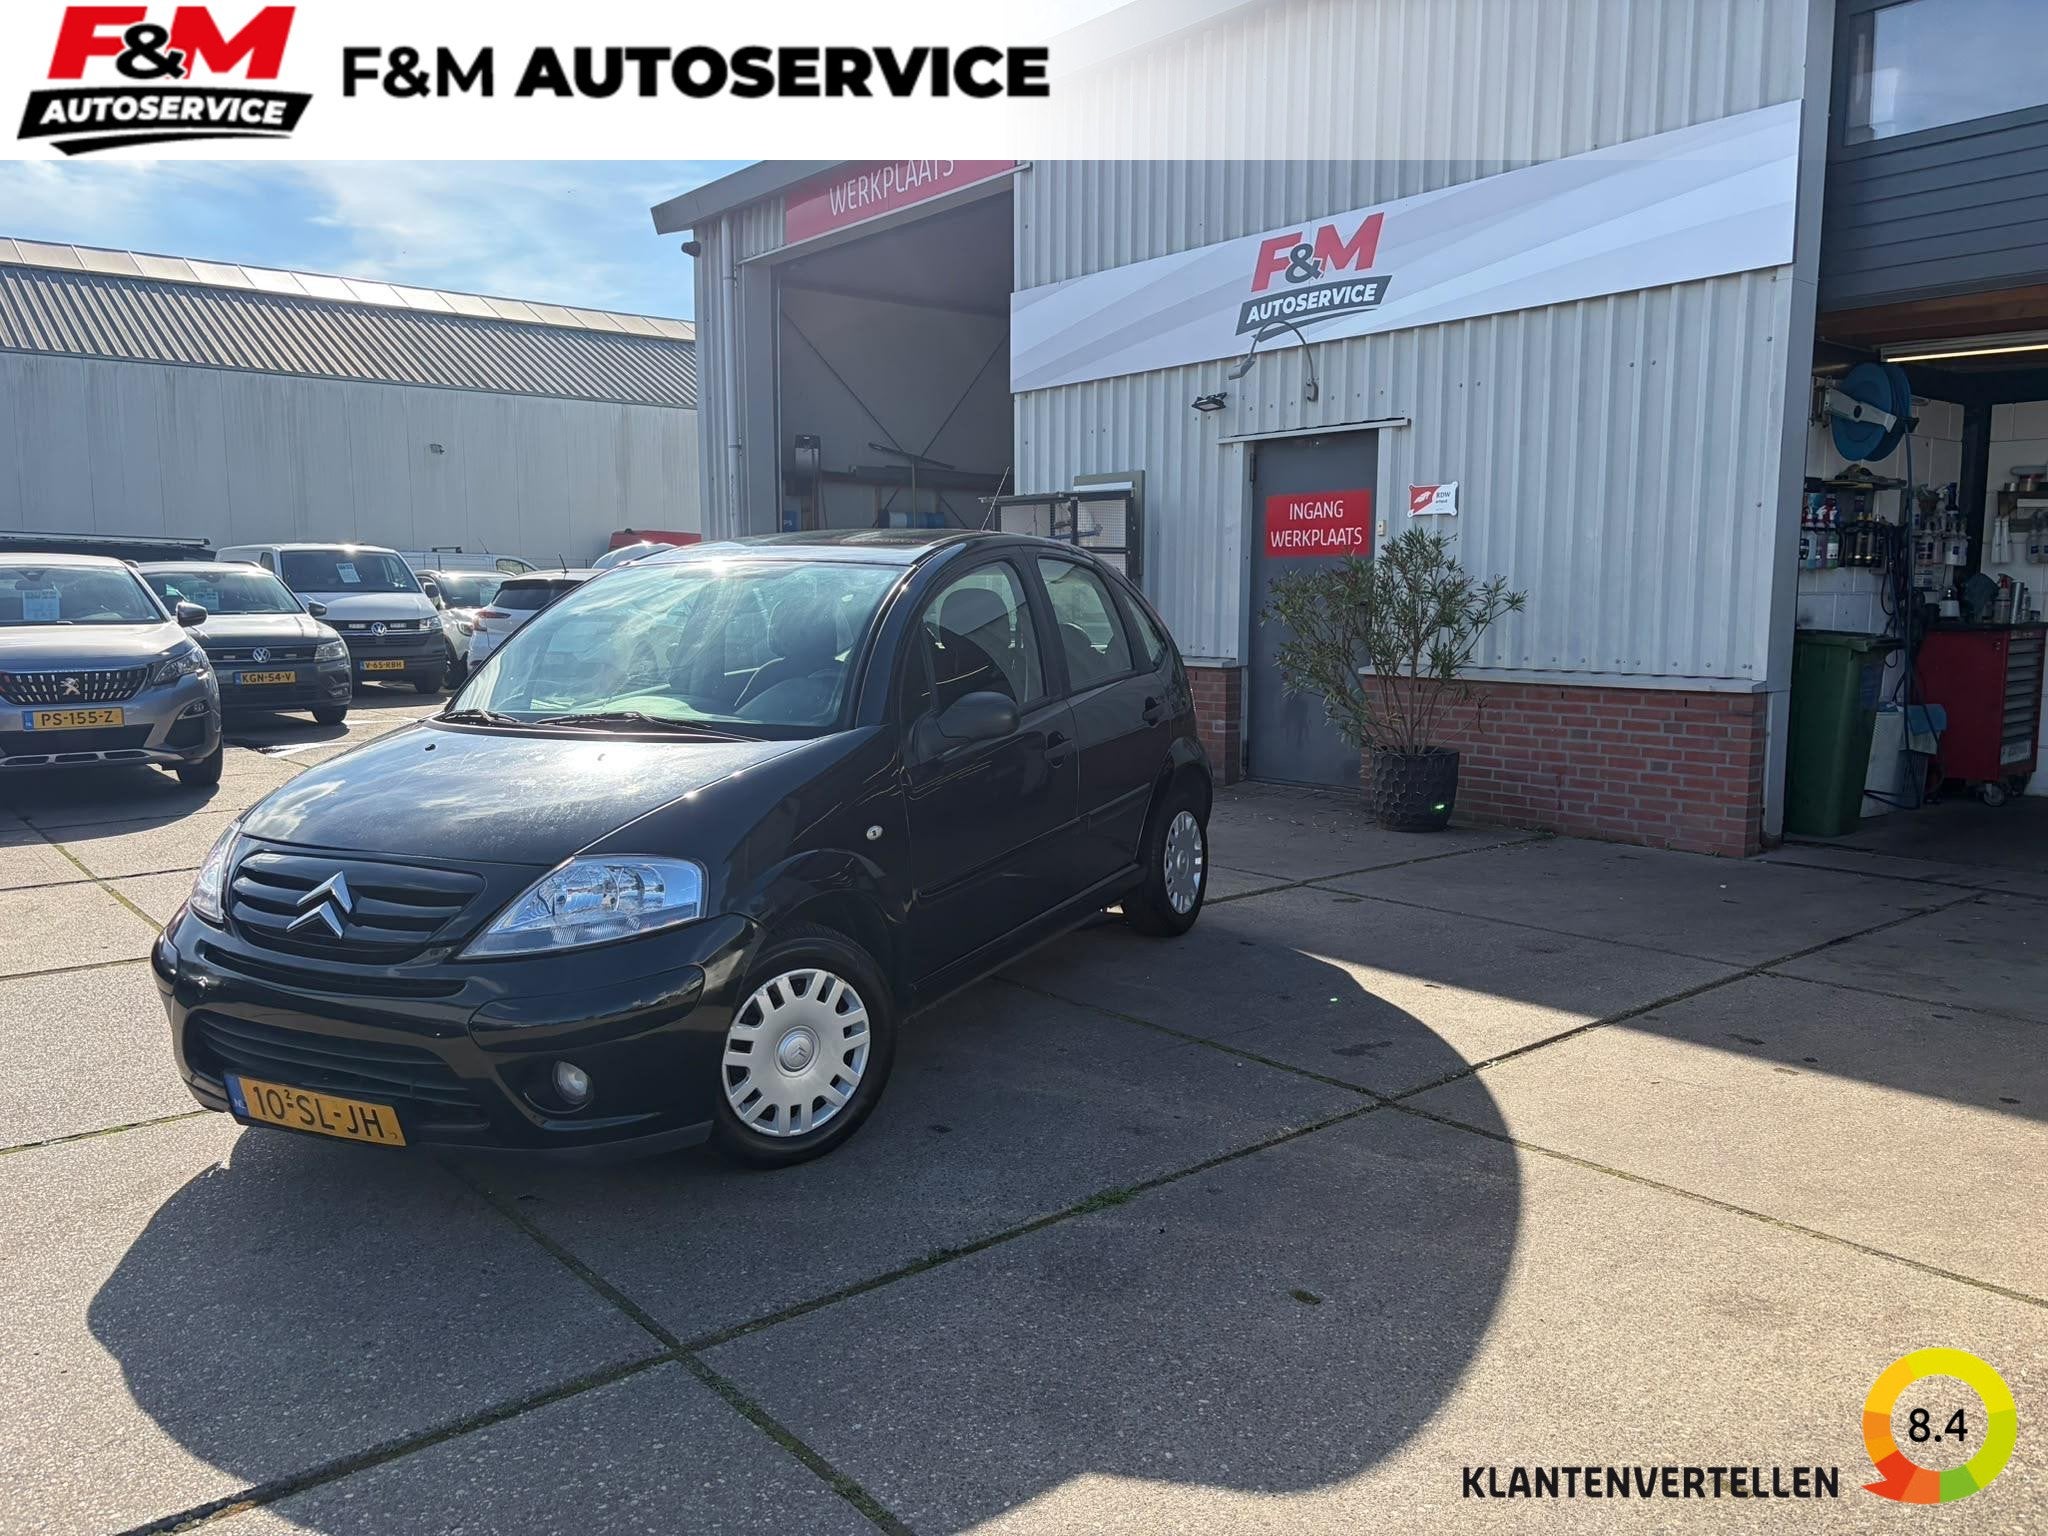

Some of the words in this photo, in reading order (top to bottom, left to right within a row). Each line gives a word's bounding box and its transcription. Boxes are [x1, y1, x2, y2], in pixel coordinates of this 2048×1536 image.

[1251, 212, 1385, 292] F&M
[1246, 283, 1378, 324] AUTOSERVICE
[1289, 500, 1344, 520] INGANG
[1270, 527, 1363, 548] WERKPLAATS
[242, 672, 292, 683] KGN-54-V
[41, 710, 114, 726] PS-155-Z
